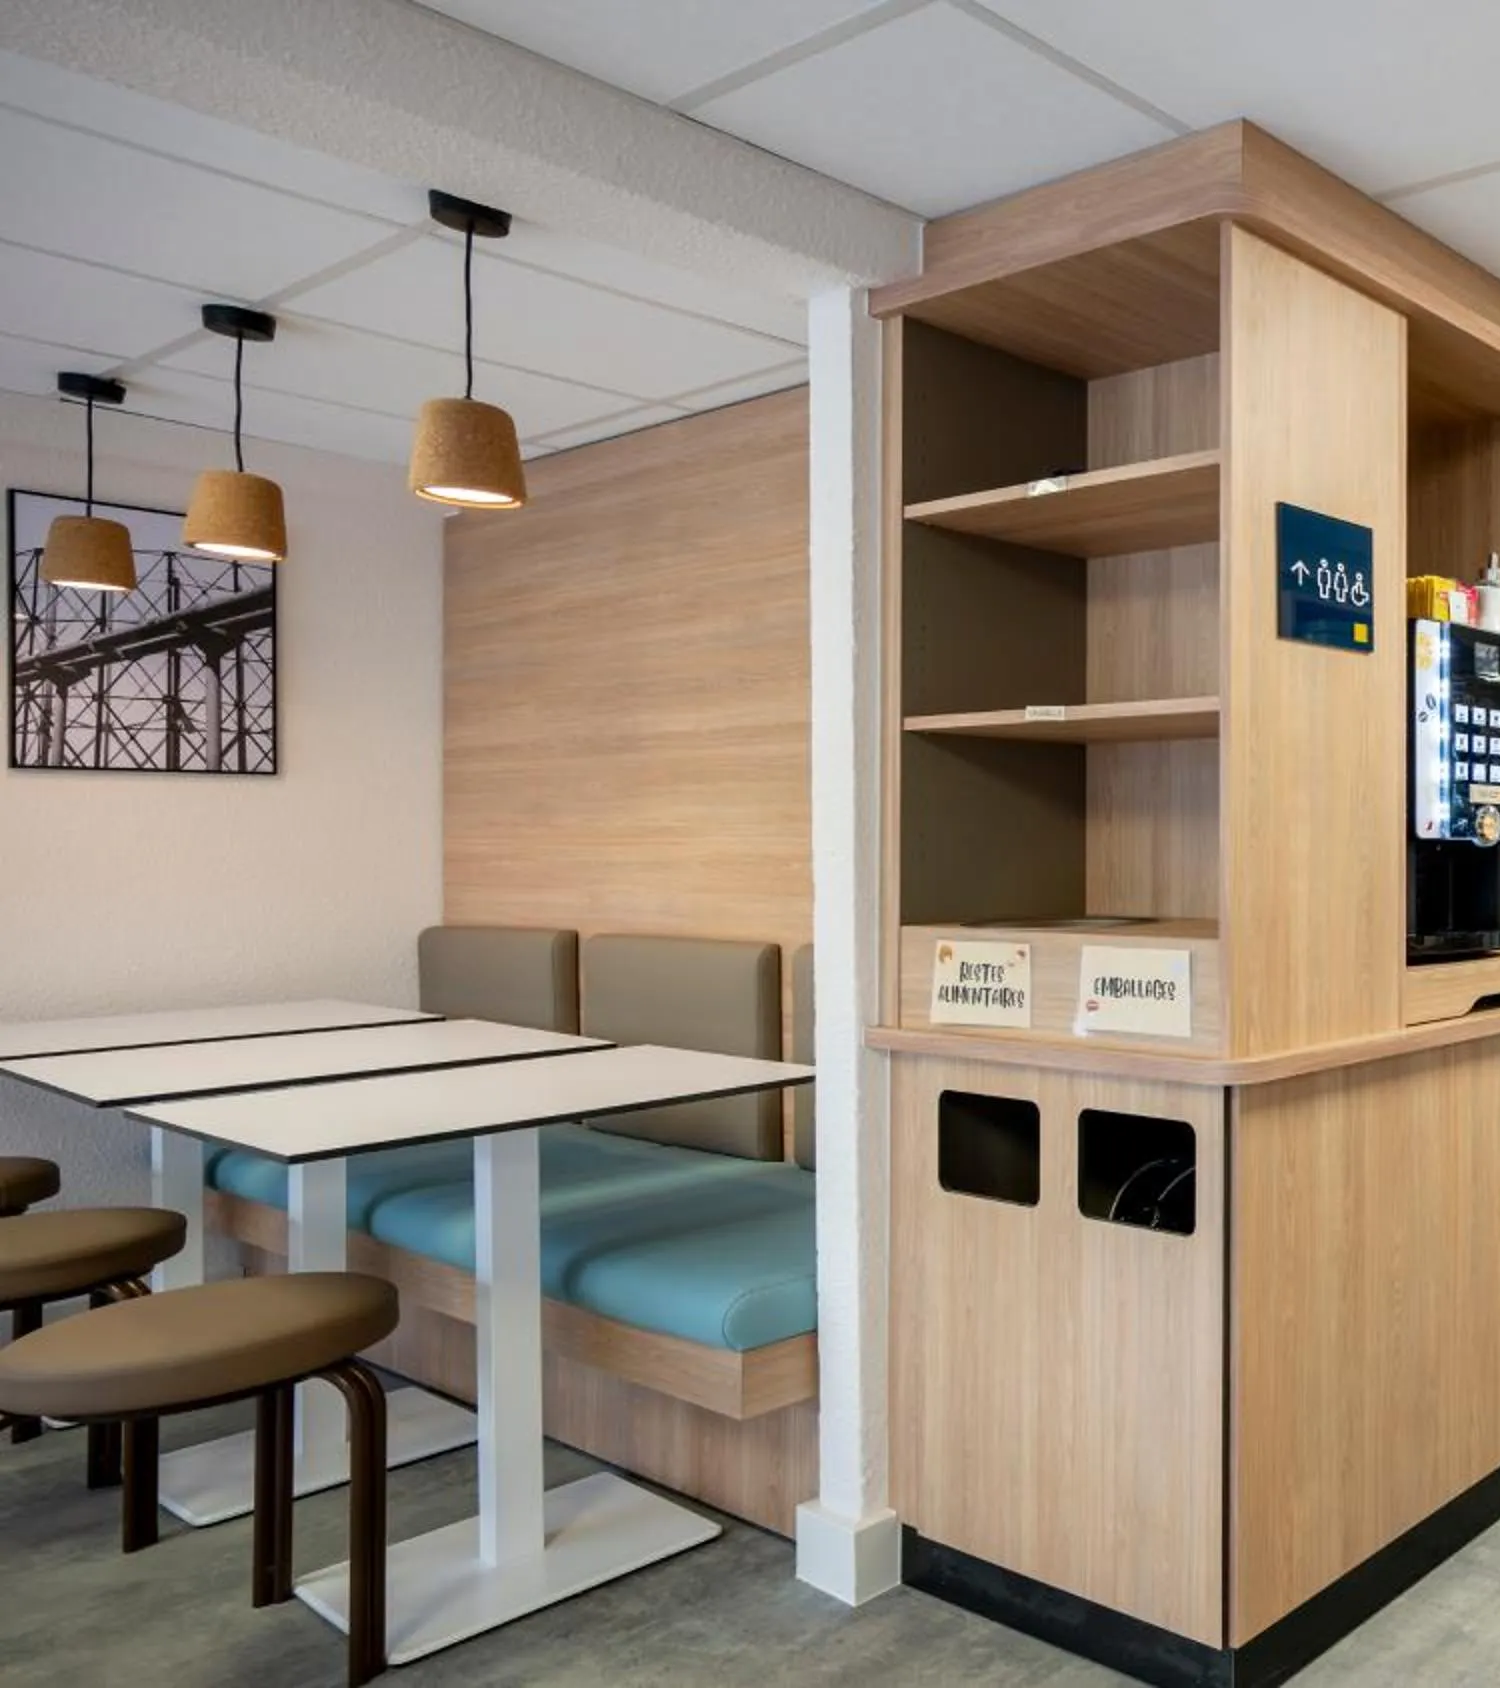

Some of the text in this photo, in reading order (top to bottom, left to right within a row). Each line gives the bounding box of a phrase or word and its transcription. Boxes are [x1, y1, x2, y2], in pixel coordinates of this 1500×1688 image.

[959, 961, 1005, 983] RESTES
[938, 985, 1025, 1009] ALIMENTAIRES
[1094, 976, 1176, 1001] EMBALLAGES
